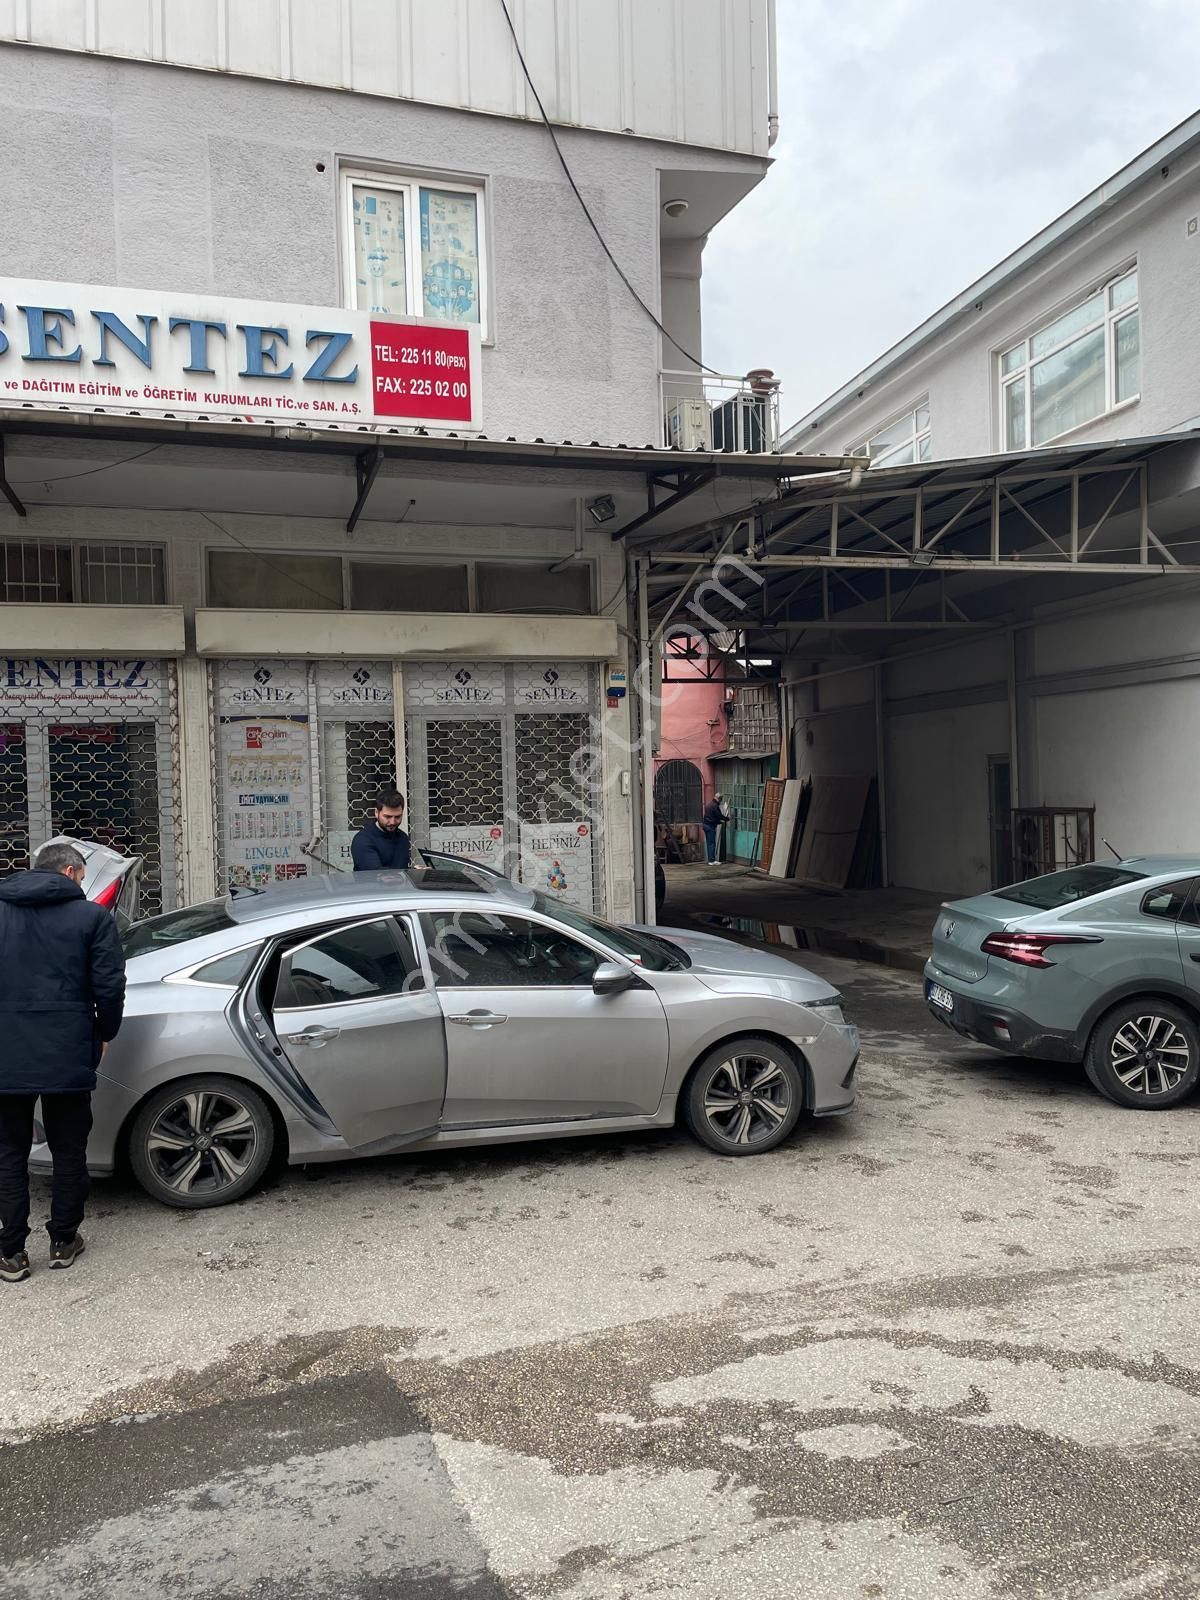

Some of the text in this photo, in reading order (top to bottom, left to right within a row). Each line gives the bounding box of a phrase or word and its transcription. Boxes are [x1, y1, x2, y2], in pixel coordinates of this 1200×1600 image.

[0, 303, 358, 384] ENTEZ
[375, 345, 398, 362] TEL:
[401, 347, 419, 364] 225
[422, 349, 431, 365] 11
[376, 376, 467, 398] FAX: 225 02 00
[5, 381, 18, 390] ve
[22, 379, 75, 393] DAĞITIM
[79, 382, 121, 397] EĞİTİM
[125, 389, 139, 398] ve
[143, 385, 197, 402] ÖĞRETİM
[204, 393, 272, 407] KURUMLARI
[313, 400, 338, 411] SAN.
[341, 402, 361, 415] A.Ş.
[0, 660, 149, 687] ENTEZ
[233, 687, 294, 701] SENTEZ
[333, 687, 392, 701] SENTEZ
[437, 687, 491, 701] SENTEZ
[526, 687, 578, 700] SENTEZ
[245, 847, 289, 860] LINGUA
